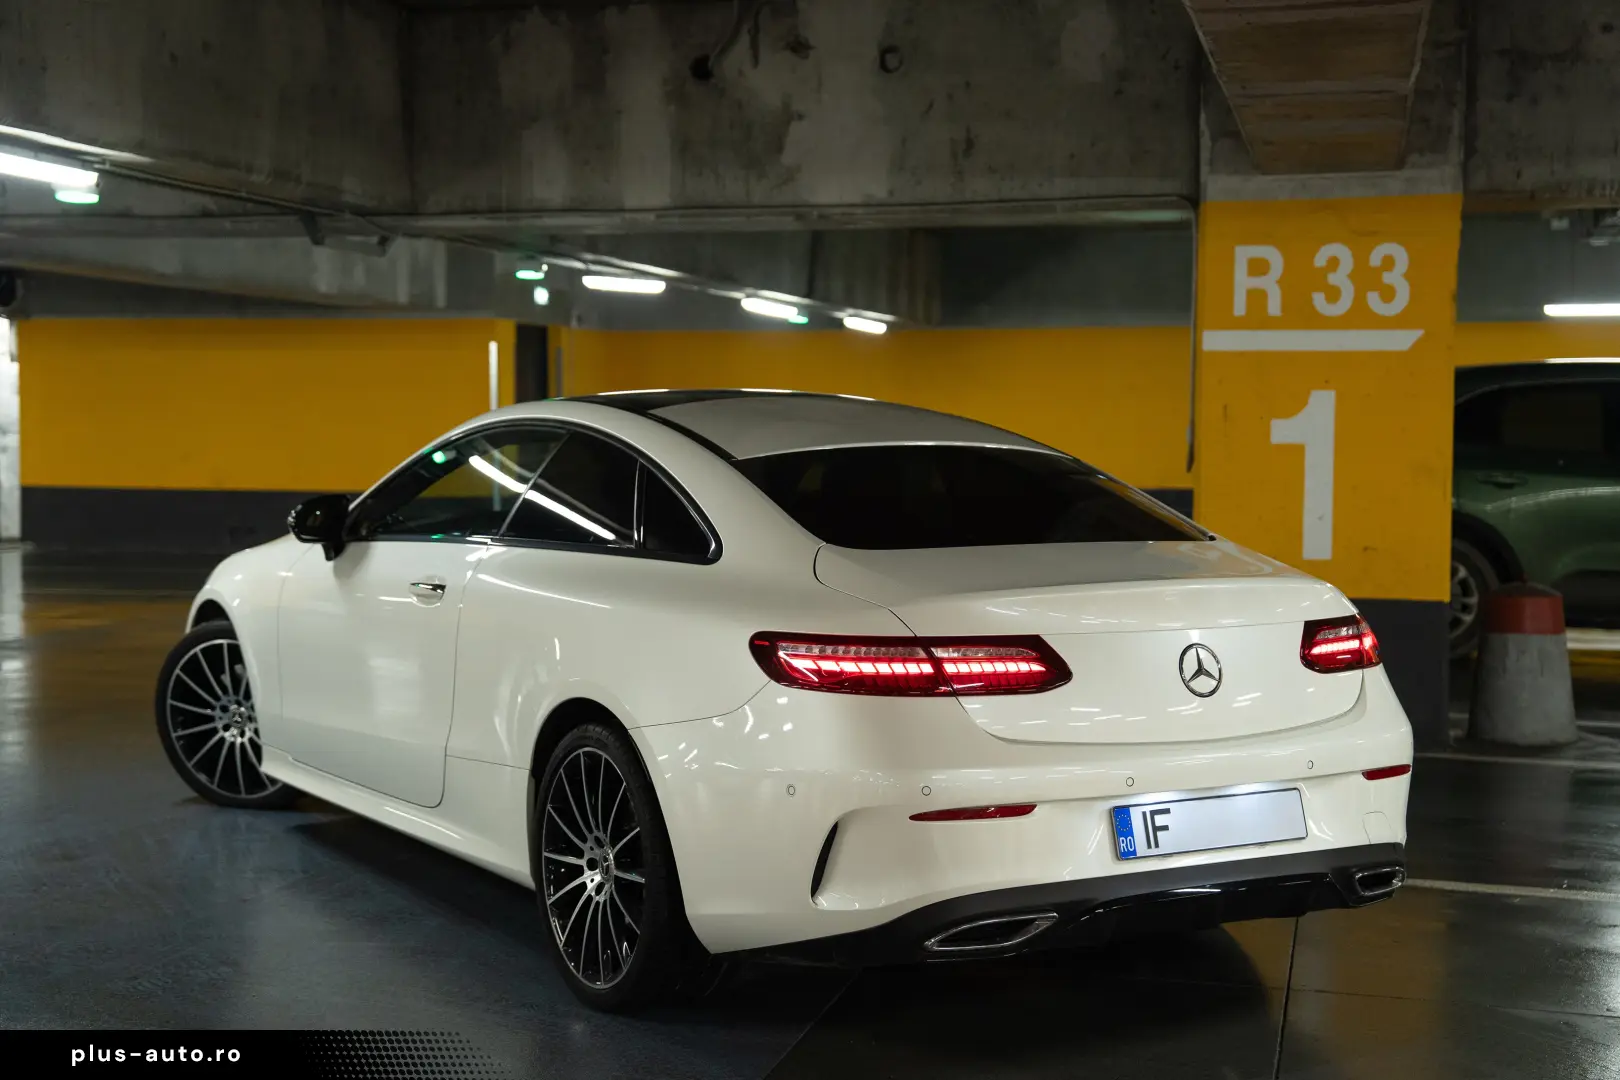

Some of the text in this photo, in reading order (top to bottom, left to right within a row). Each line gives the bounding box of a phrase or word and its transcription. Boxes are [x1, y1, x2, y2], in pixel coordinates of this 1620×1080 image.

[1233, 242, 1411, 317] R 33
[1270, 389, 1336, 560] 1
[1119, 836, 1135, 853] RO
[1141, 807, 1171, 849] IF
